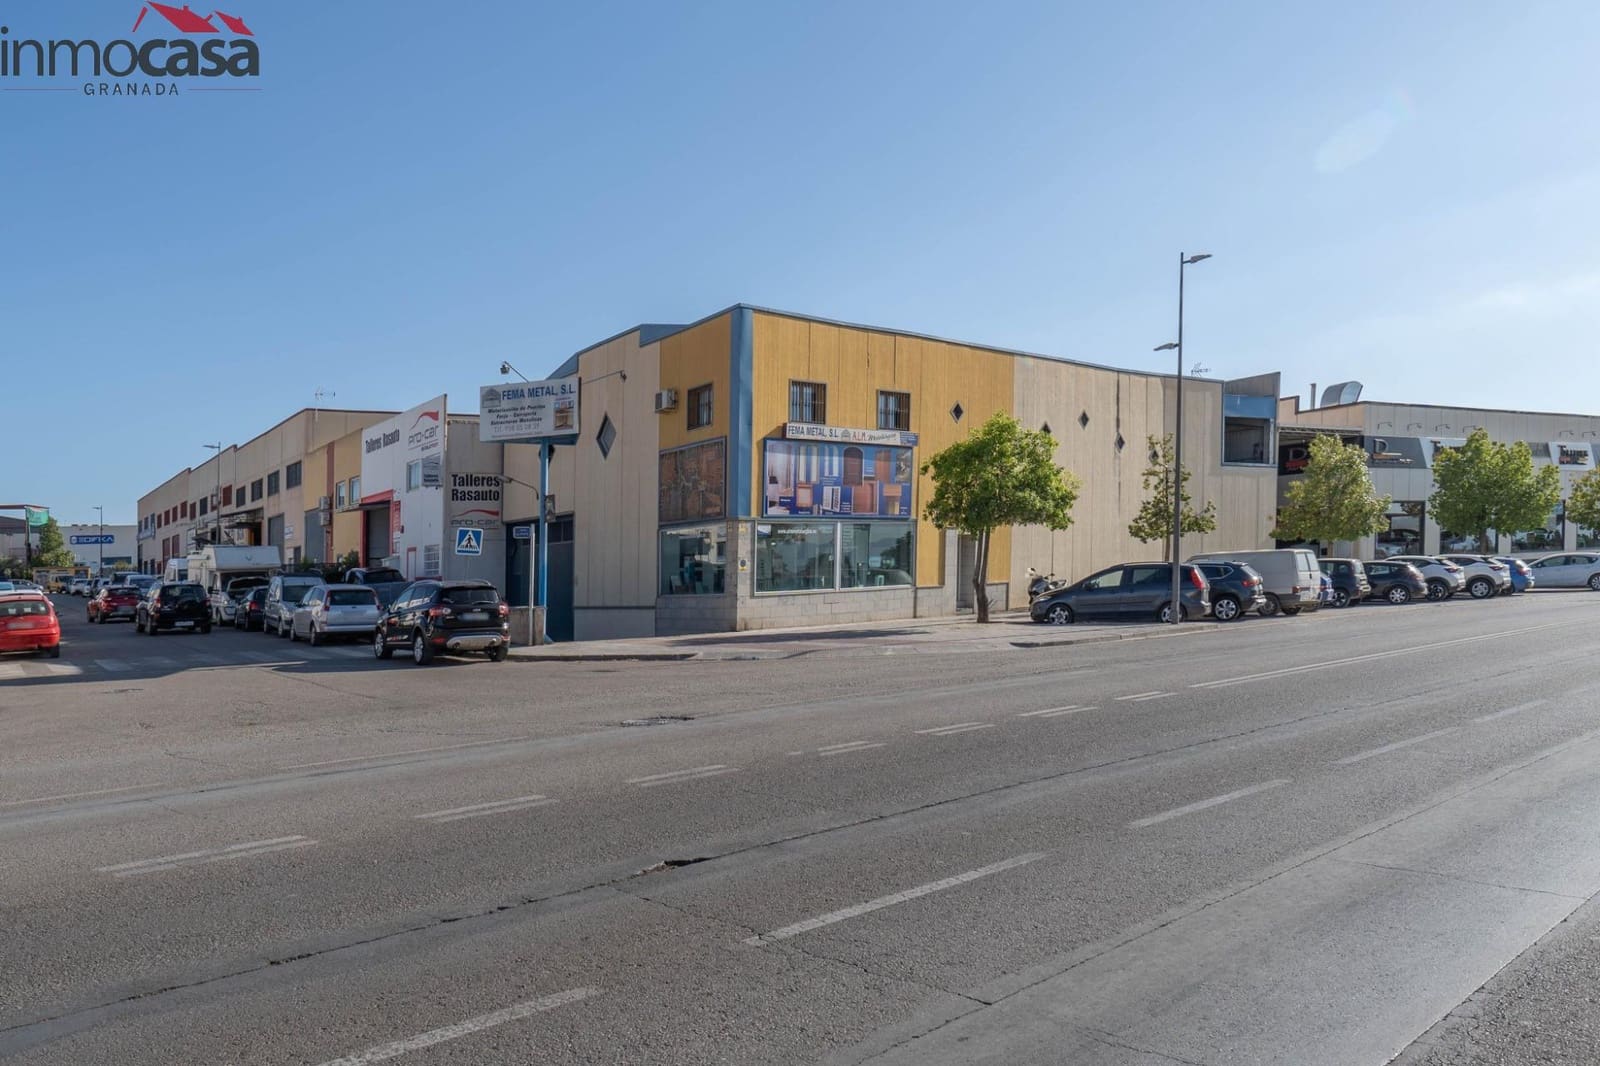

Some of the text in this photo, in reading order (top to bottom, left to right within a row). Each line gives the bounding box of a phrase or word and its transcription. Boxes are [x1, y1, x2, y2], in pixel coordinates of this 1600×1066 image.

[502, 388, 525, 400] FEMA
[788, 425, 804, 435] FEMA
[365, 436, 382, 454] Talleres
[383, 428, 400, 448] Rasauto
[451, 474, 500, 487] Talleres
[451, 488, 500, 502] Rasauto
